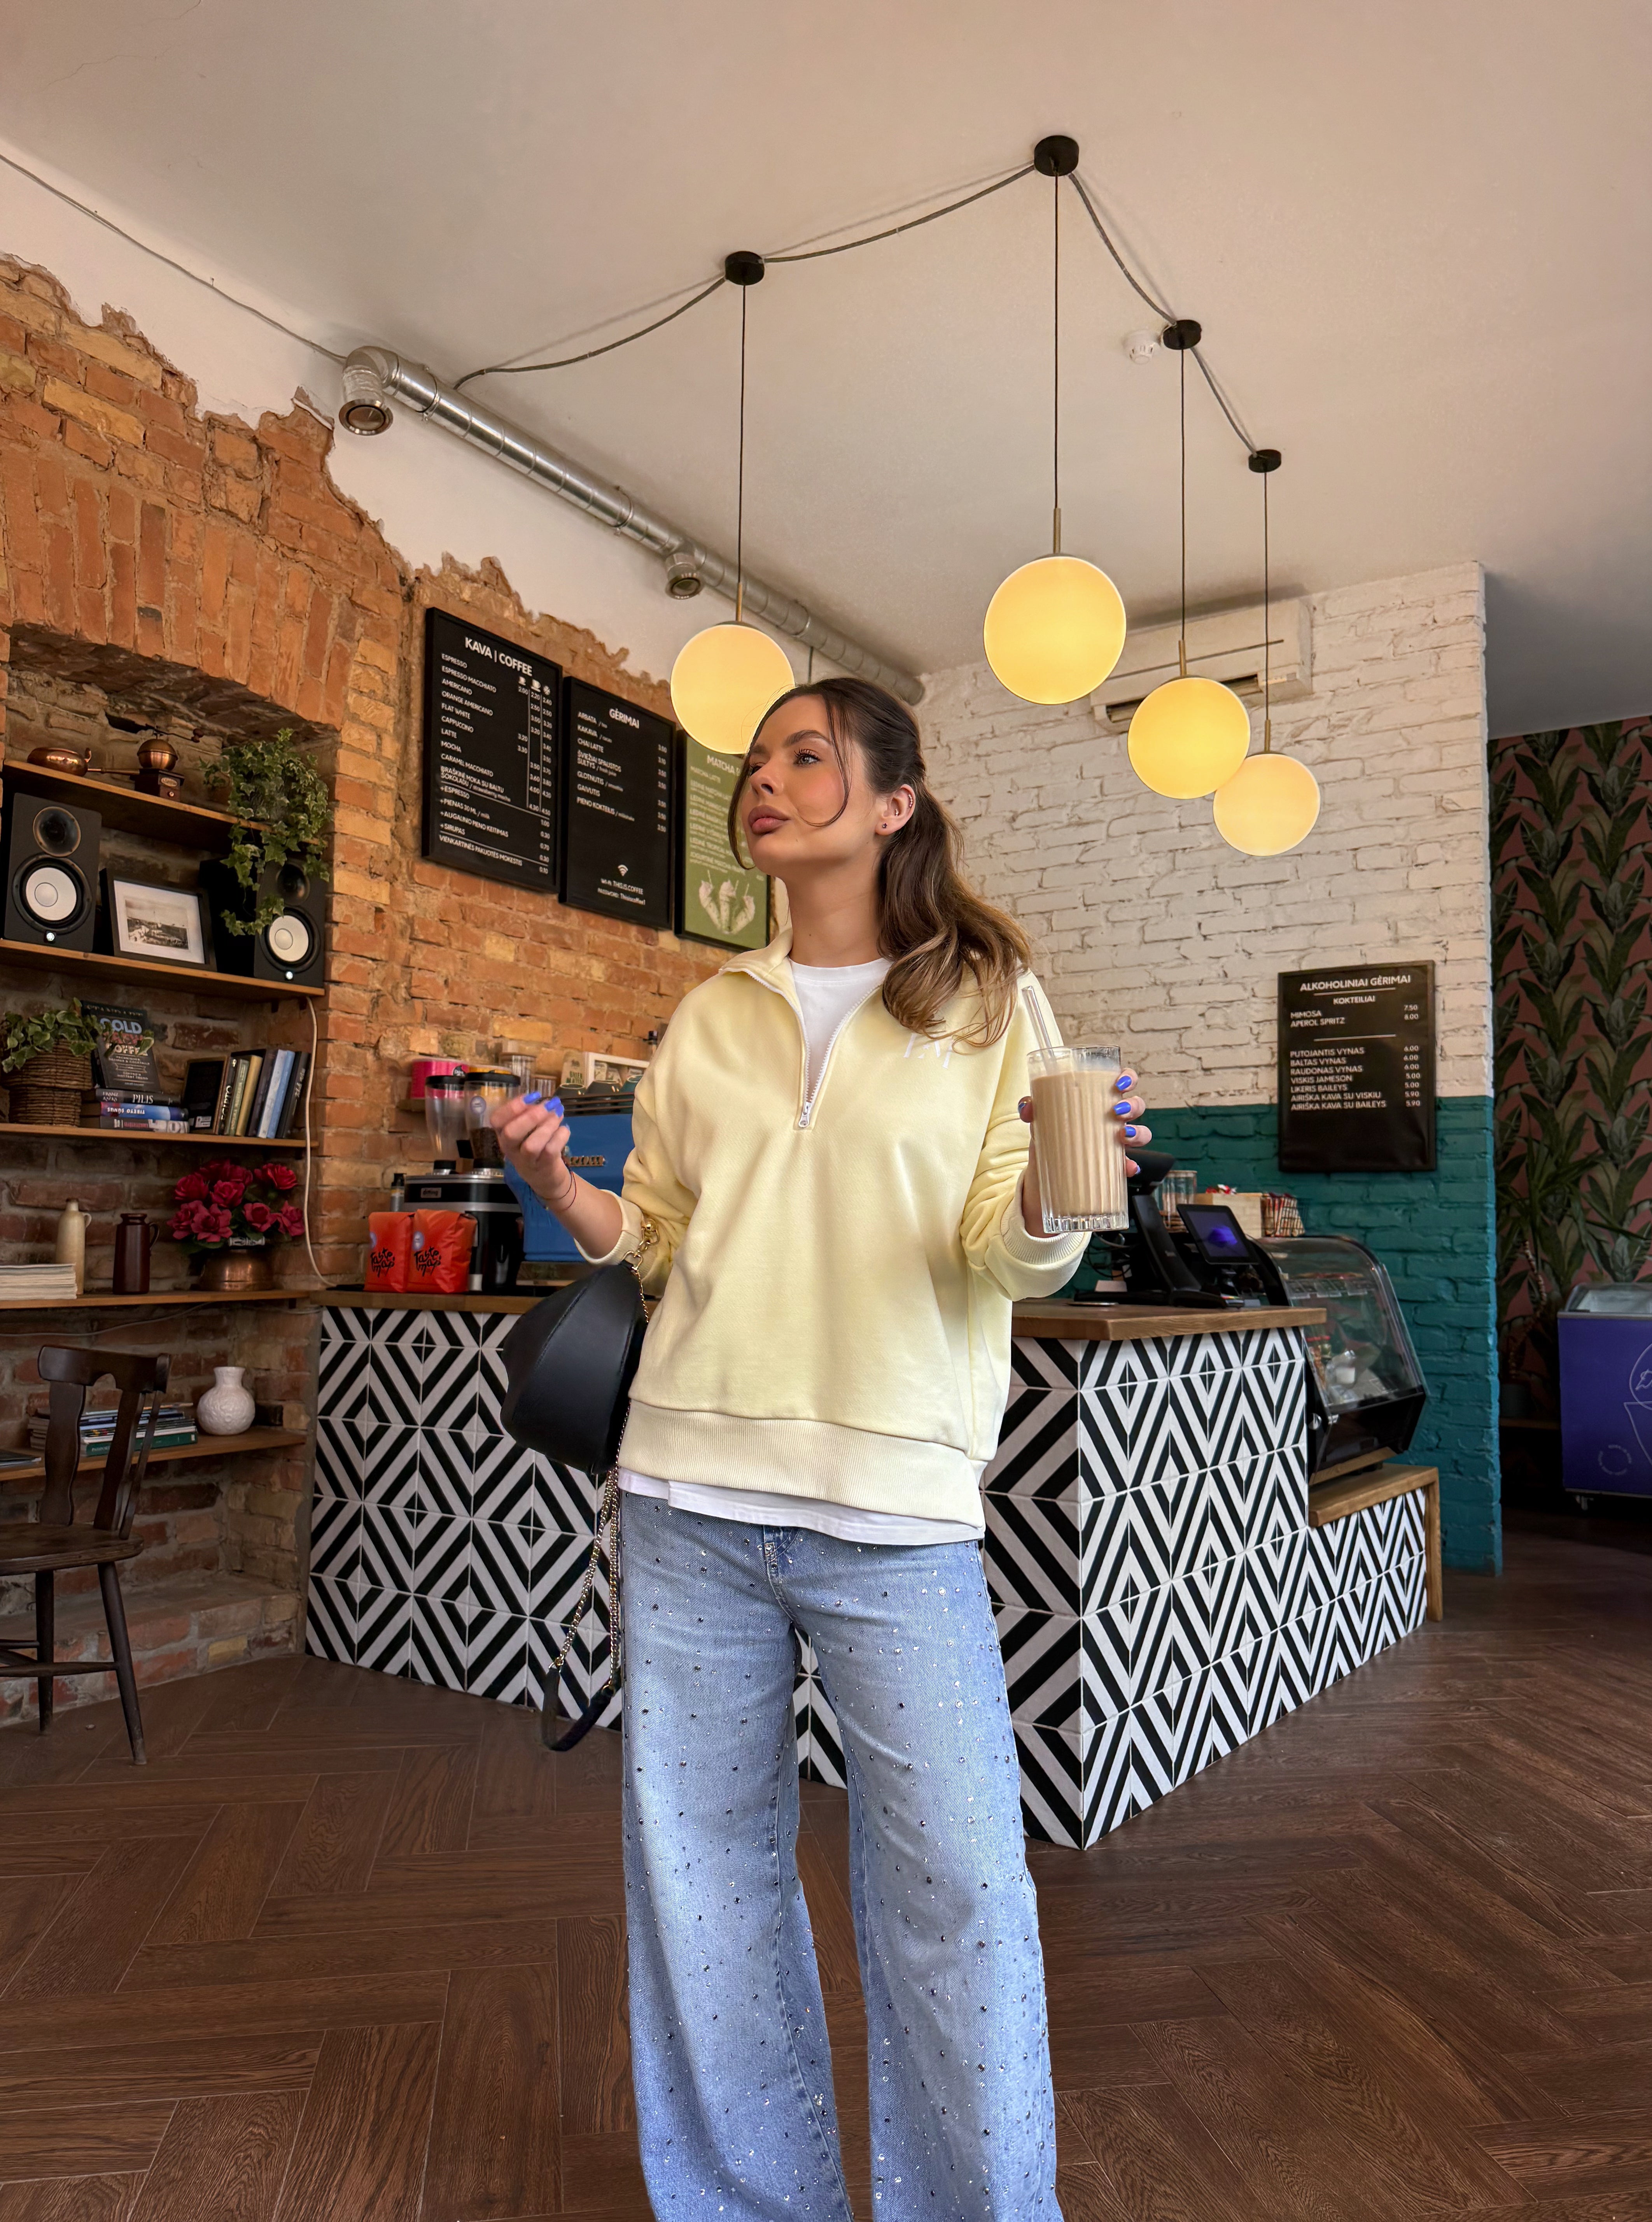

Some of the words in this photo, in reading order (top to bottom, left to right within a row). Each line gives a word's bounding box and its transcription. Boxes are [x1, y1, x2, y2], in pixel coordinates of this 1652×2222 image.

[465, 637, 492, 659] KAVA
[499, 653, 532, 676] COFFEE
[441, 653, 467, 668] ESPRESSO
[531, 692, 540, 700] 2.20
[442, 666, 467, 681] ESPRESSO
[468, 676, 496, 693] MACCHIATO
[442, 678, 472, 695] AMERICANO
[442, 691, 464, 704] ORANGE
[464, 700, 493, 716] AMERICANO
[441, 703, 454, 713] FLAT
[455, 707, 470, 719] WHITE
[441, 716, 474, 733] CAPPUCCINO
[609, 708, 639, 729] GĖRIMAI
[441, 728, 457, 738] LATTE
[441, 741, 462, 753] MOCHA
[577, 738, 590, 747] CHAI
[590, 742, 604, 753] LATTE
[441, 753, 465, 766] CARAMEL
[466, 762, 493, 777] MACCHIATO
[577, 757, 595, 769] SULTYS
[598, 758, 621, 772] SPAUSTOS
[707, 755, 735, 775] MATCHA
[467, 774, 481, 785] MOKA
[489, 783, 504, 793] BALTU
[472, 819, 486, 830] PIENO
[499, 853, 523, 866] MOKESTIS
[1300, 978, 1368, 992] ALKOHOLINIAI
[1370, 975, 1411, 986] GĖRIMAI
[1333, 995, 1376, 1005] KOKTEILIAI
[1290, 1010, 1322, 1019] MIMOSA
[1290, 1019, 1318, 1028] APEROL
[1320, 1017, 1345, 1025] SPRITZ
[1290, 1049, 1335, 1058] PUTOJANTIS
[1290, 1058, 1318, 1067] BALTAS
[1319, 1057, 1346, 1065] VYNAS
[1290, 1067, 1334, 1076] RAUDONAS
[1316, 1074, 1352, 1083] JAMESON
[1291, 1085, 1316, 1093] LIKERIS
[1318, 1083, 1347, 1092] BAILEYS
[132, 1093, 153, 1104] PILIS
[1291, 1093, 1320, 1102] AIRIŠKA
[1291, 1102, 1320, 1111] AIRIŠKA
[1356, 1100, 1386, 1109] BAILEYS
